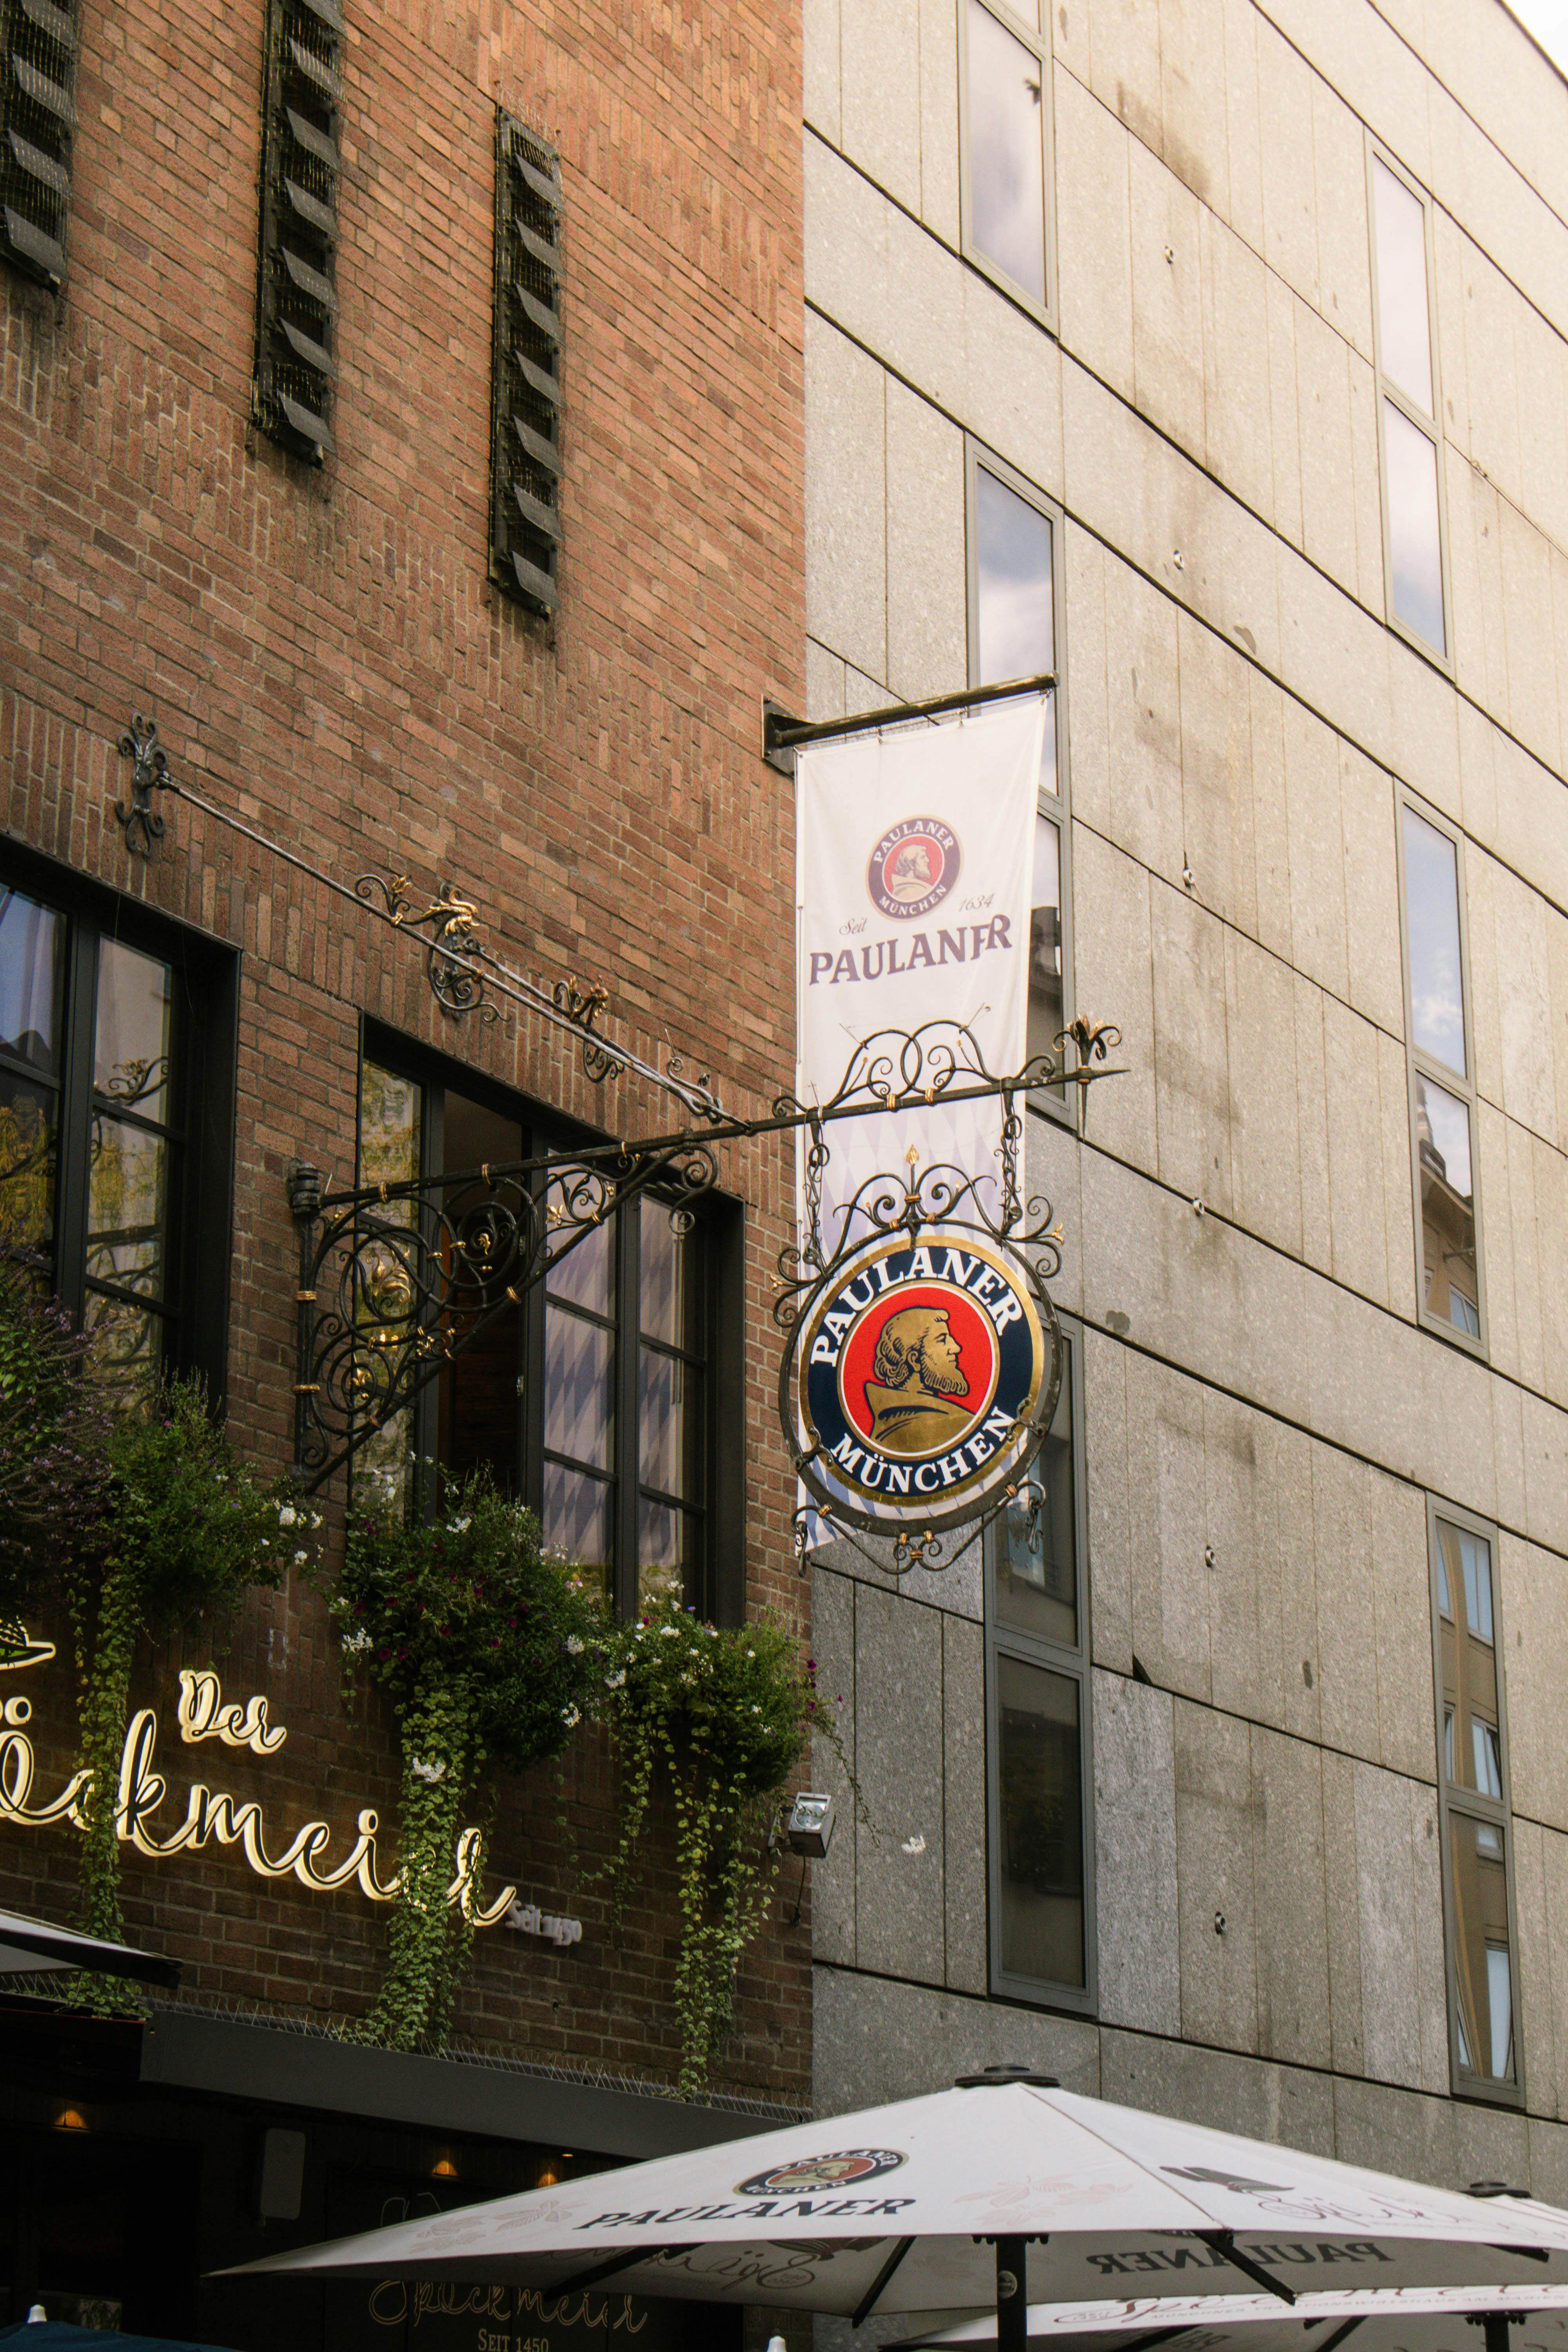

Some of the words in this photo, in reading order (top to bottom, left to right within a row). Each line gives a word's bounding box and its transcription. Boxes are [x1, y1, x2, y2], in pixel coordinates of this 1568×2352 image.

[873, 819, 954, 864] PAULANER
[838, 916, 868, 936] Seit
[958, 893, 996, 913] 1634
[878, 884, 947, 916] MÜNCHEN
[809, 1246, 1023, 1367] PAULANER
[829, 1406, 1016, 1494] MÜNCHEN
[178, 1668, 287, 1755] Der
[571, 2198, 916, 2230] PAULANER
[515, 2336, 549, 2352] 1450
